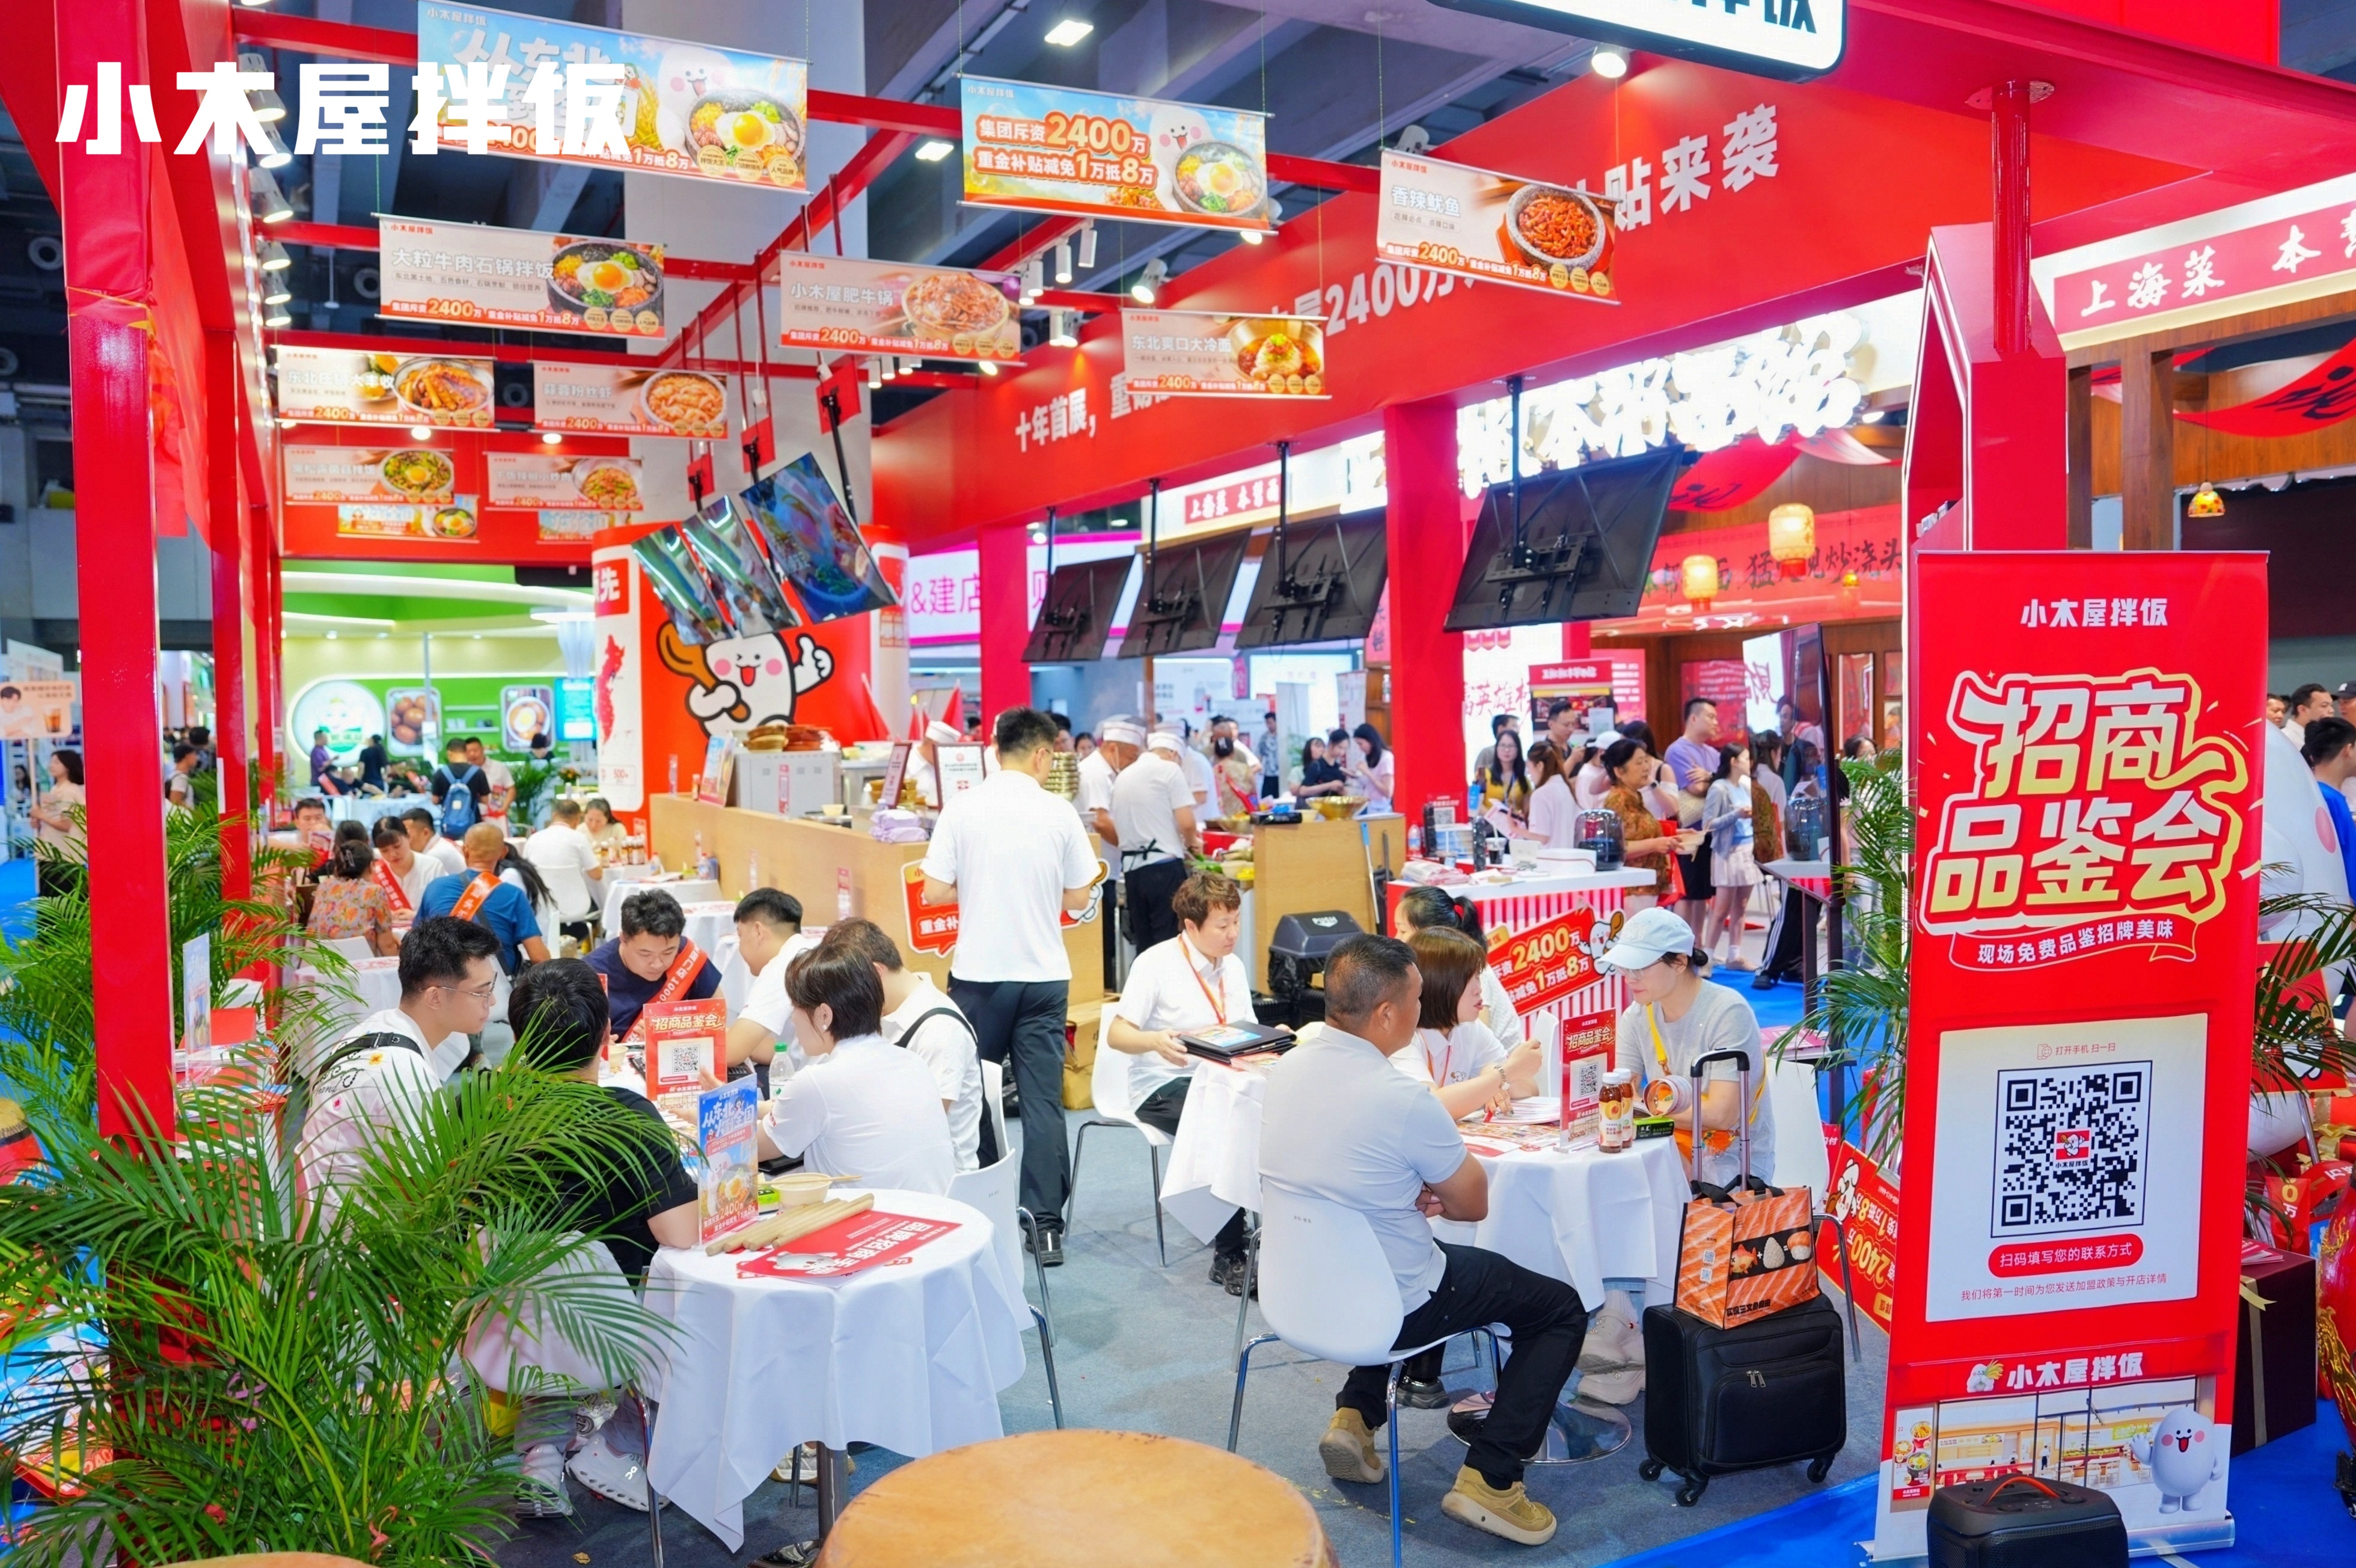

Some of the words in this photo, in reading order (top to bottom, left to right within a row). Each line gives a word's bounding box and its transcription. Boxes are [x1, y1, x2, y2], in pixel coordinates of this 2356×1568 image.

[427, 7, 486, 26] 小木屋拌饭
[979, 111, 1146, 155] 集团斥资2400万
[977, 149, 1154, 185] 重金补贴减免1万抵8万
[1391, 185, 1461, 218] 香辣鱿鱼
[391, 248, 555, 281] 大粒牛肉石锅拌饭
[1015, 388, 1096, 452] 十年首展，
[1564, 102, 1779, 232] 贴来袭
[791, 282, 893, 307] 小木屋肥牛锅
[2081, 245, 2226, 317] 上海菜
[1131, 335, 1232, 353] 东北爽口大冷面
[2020, 598, 2168, 628] 小木屋拌饭
[1960, 681, 2223, 798] 招商
[1930, 790, 2223, 914] 品鉴会
[1977, 919, 2174, 966] 现场免费品鉴招牌美味
[651, 1013, 723, 1031] 招商品鉴会
[1566, 1026, 1614, 1049] 招商品鉴会
[2055, 1043, 2089, 1056] 打开手机
[2091, 1041, 2116, 1054] 扫一扫
[702, 1101, 735, 1129] 从东北
[2000, 1242, 2133, 1269] 扫码填写您的联系方式
[1960, 1272, 2168, 1302] 我们将第一时间为您发送加盟政策与开店详情
[1726, 1299, 1772, 1317] 实现三文鱼自由
[2007, 1351, 2143, 1389] 小木屋拌饭
